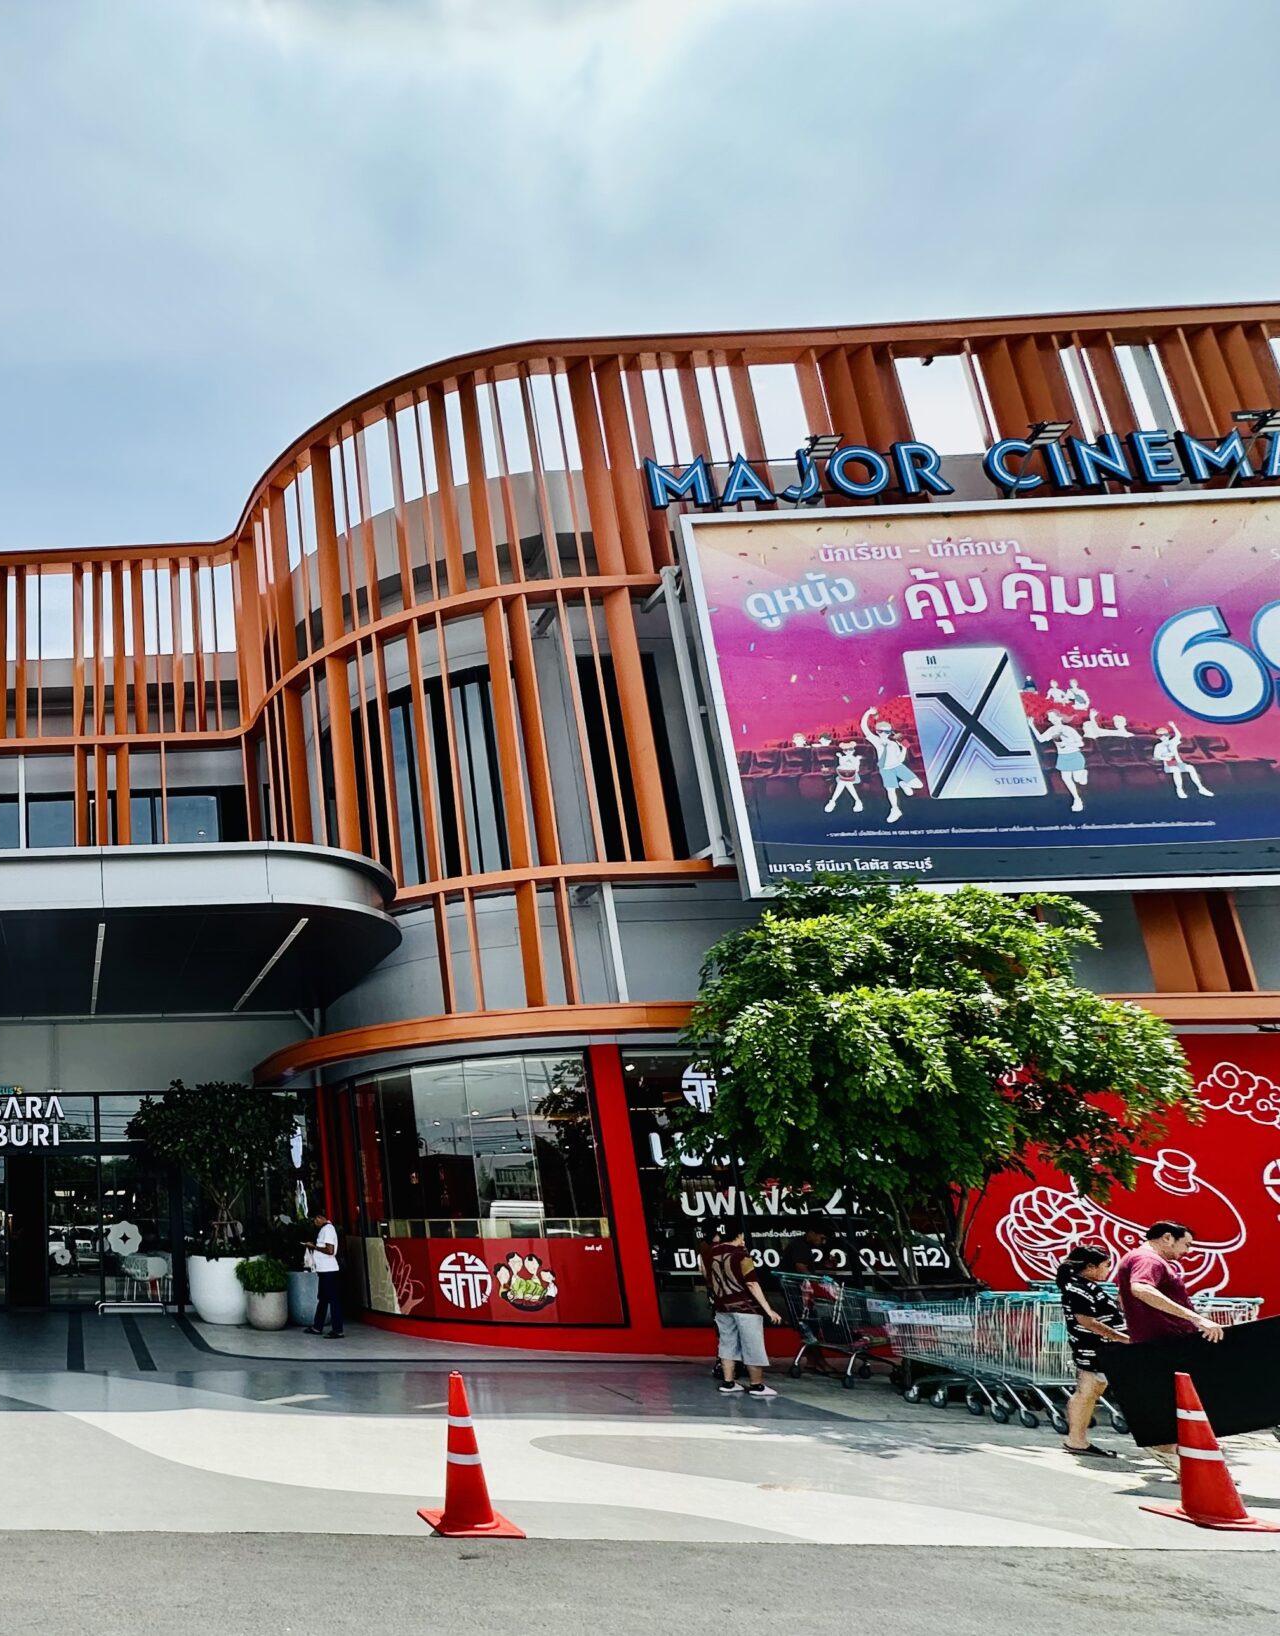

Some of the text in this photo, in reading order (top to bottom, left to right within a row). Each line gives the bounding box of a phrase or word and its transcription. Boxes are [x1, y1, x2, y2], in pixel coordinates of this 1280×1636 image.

[644, 441, 955, 509] MAJOR
[820, 542, 902, 562] นักเรียน
[928, 538, 1022, 558] นักศึกษา
[746, 572, 856, 628] ดูหนัง
[904, 556, 1119, 635] คุ้ม คุ้ม!
[830, 599, 897, 636] แบบ
[1060, 646, 1131, 668] เริ่มต้น
[994, 776, 1039, 785] STUDENT
[769, 859, 812, 873] เมเจอร์
[854, 858, 889, 871] โลตัส
[893, 856, 933, 873] สระบุรี
[674, 1247, 703, 1269] เปิ
